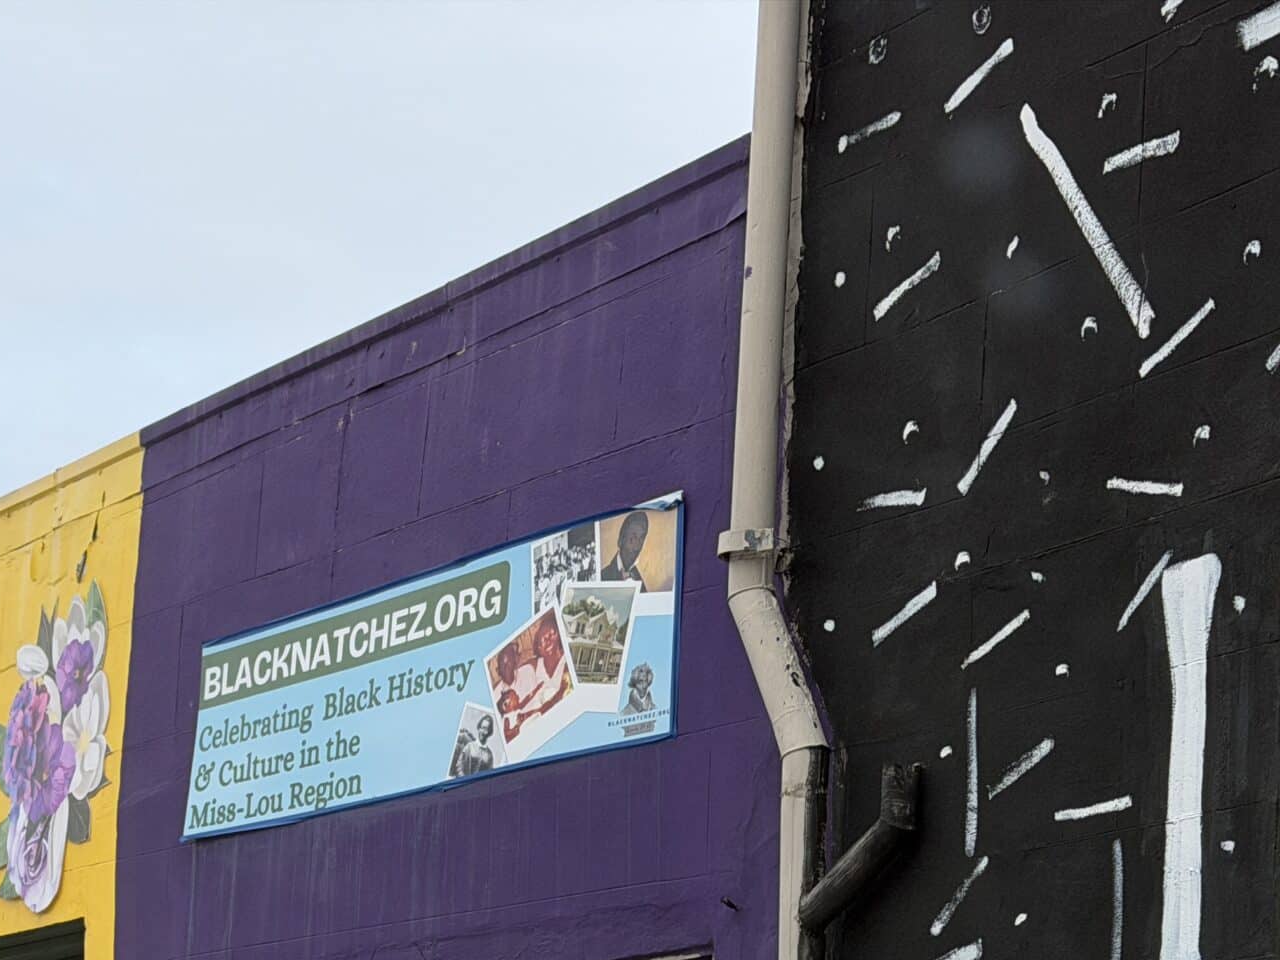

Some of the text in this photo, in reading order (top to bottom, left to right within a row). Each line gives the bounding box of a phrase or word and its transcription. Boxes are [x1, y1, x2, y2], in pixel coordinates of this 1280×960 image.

[203, 579, 503, 701] BLACKNATCHEZ.ORG
[199, 657, 475, 752] Celebrating Black History
[194, 731, 361, 792] & Culture in the
[188, 772, 362, 830] Miss-Lou Region
